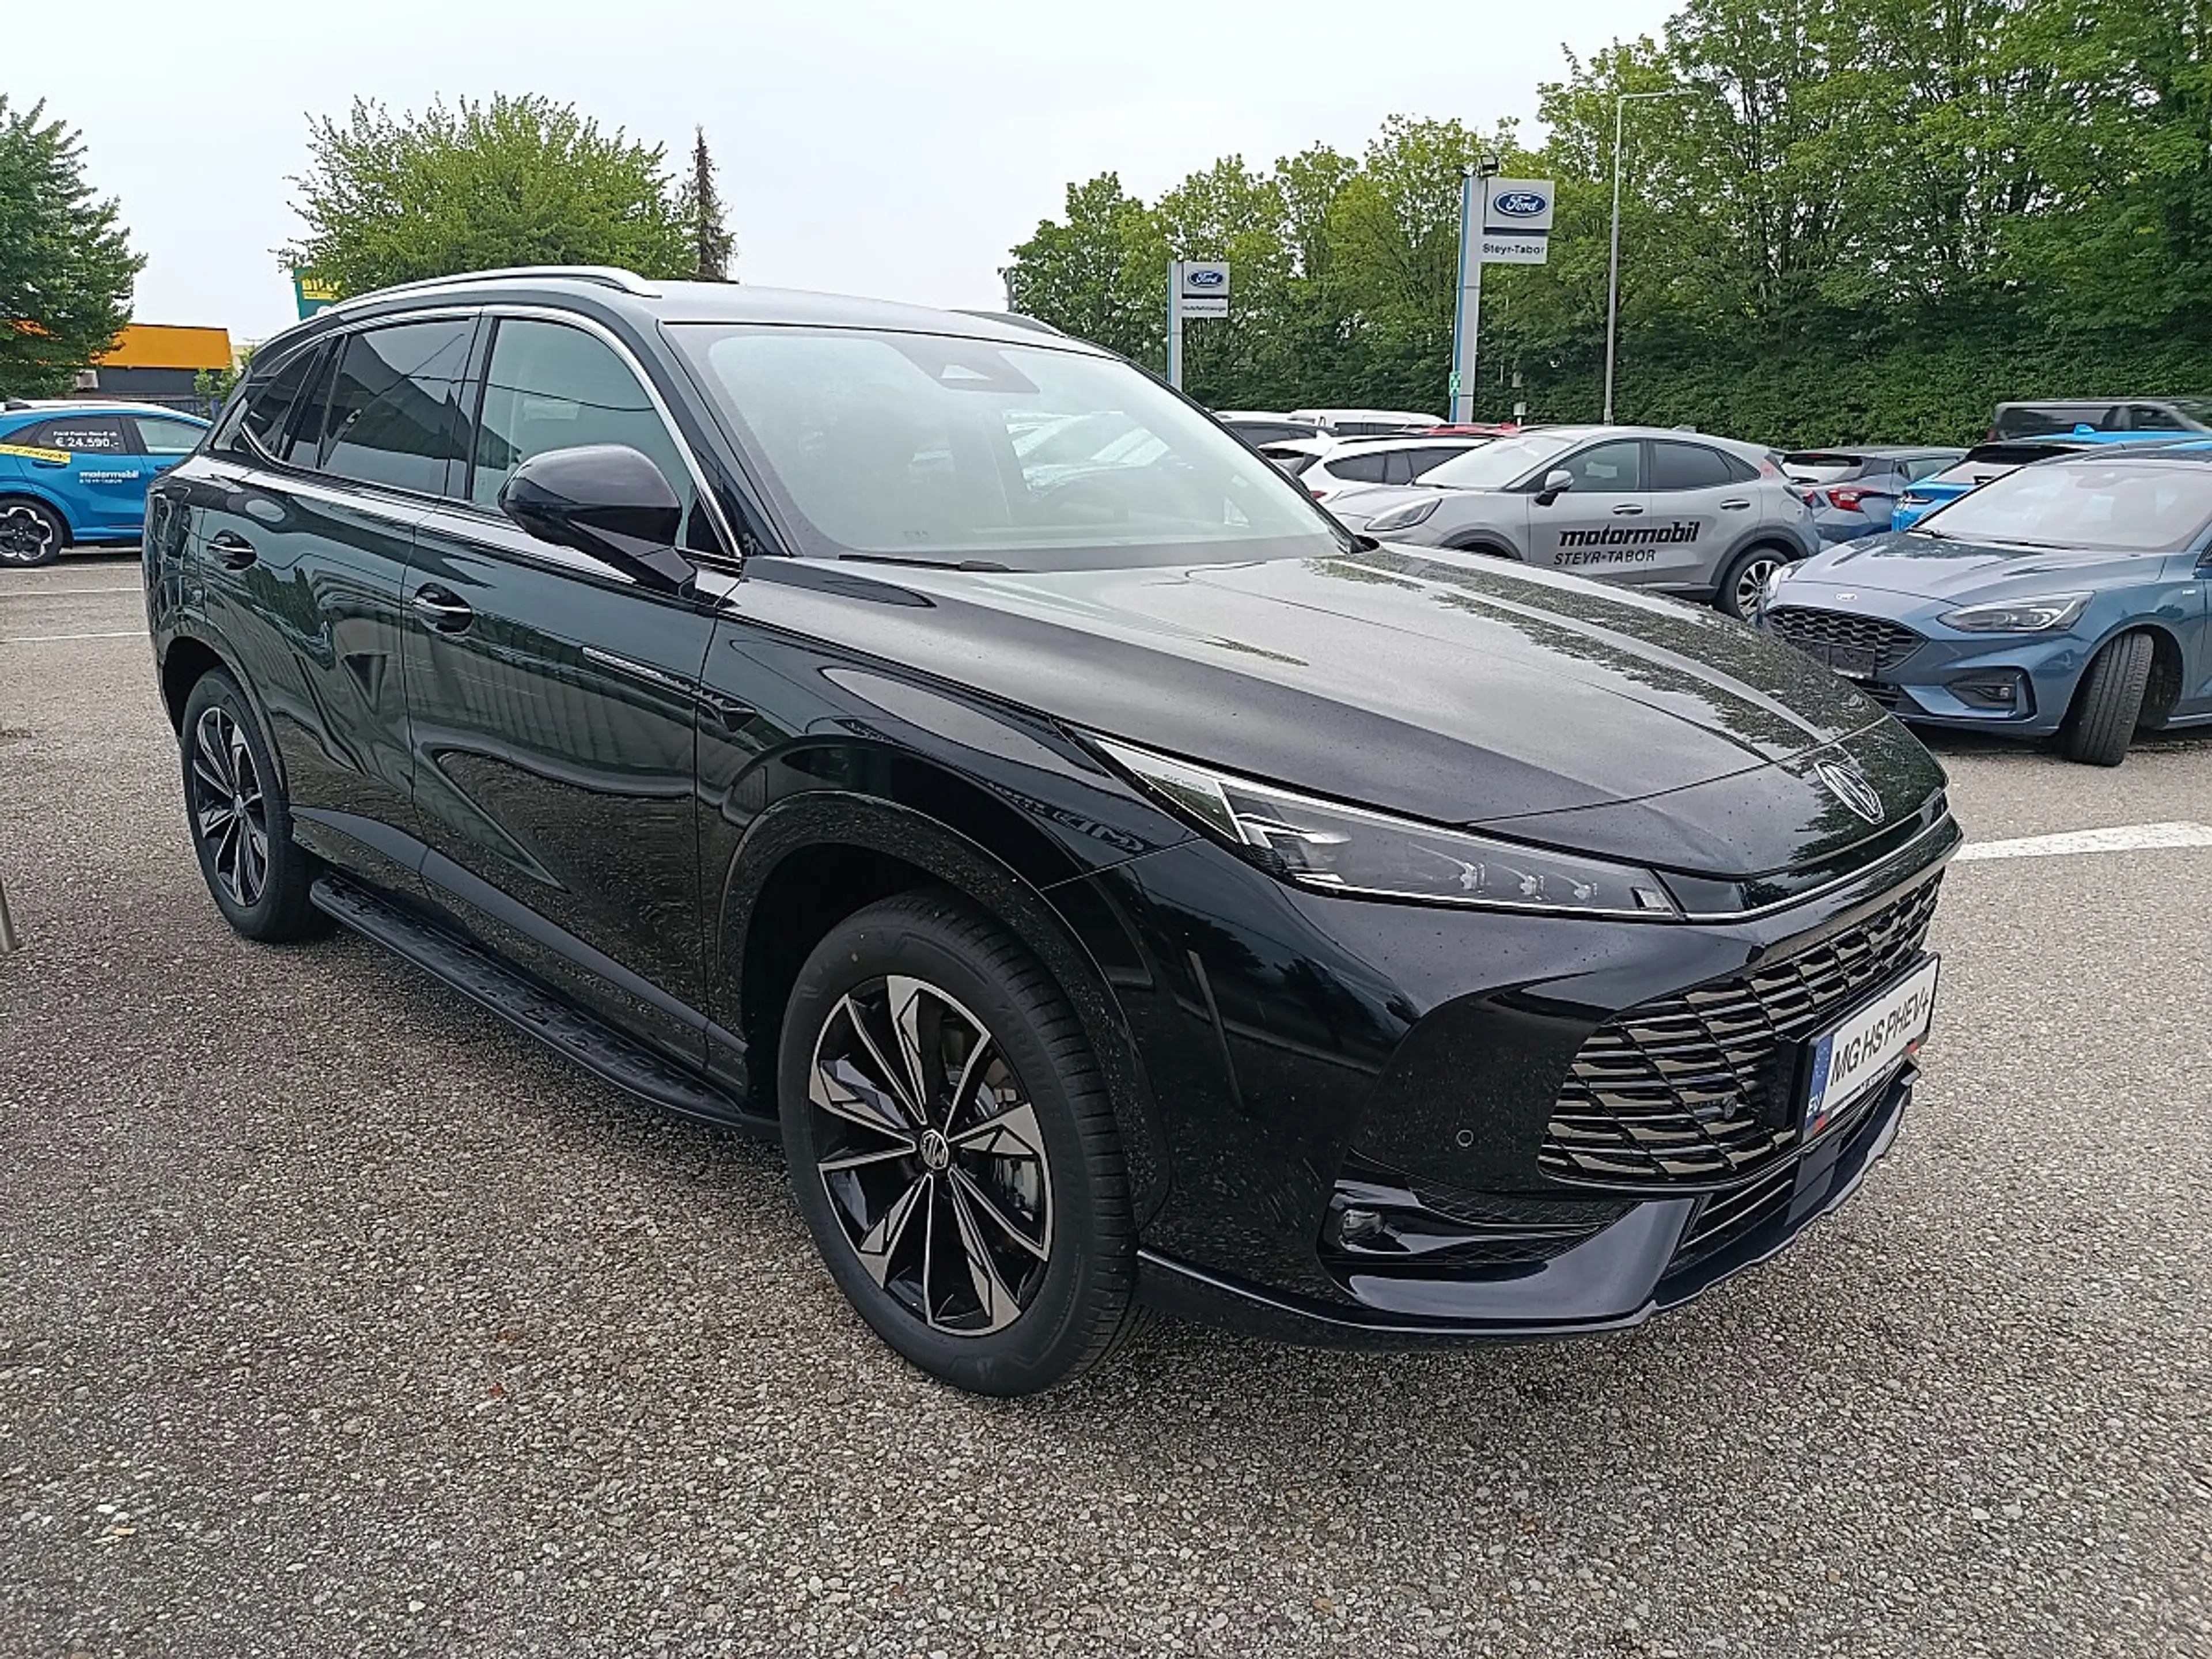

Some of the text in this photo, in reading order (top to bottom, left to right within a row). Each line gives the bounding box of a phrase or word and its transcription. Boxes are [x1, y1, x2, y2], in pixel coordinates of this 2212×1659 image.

[1482, 243, 1546, 255] Steyr-Tabor
[55, 437, 64, 447] €
[79, 469, 139, 479] motormobil
[1559, 521, 1700, 547] motormobil
[1554, 549, 1657, 566] STEYR-TABOR
[1829, 1035, 1861, 1086] MG
[1861, 1018, 1885, 1064] HS
[1884, 987, 1929, 1046] PHEV+
